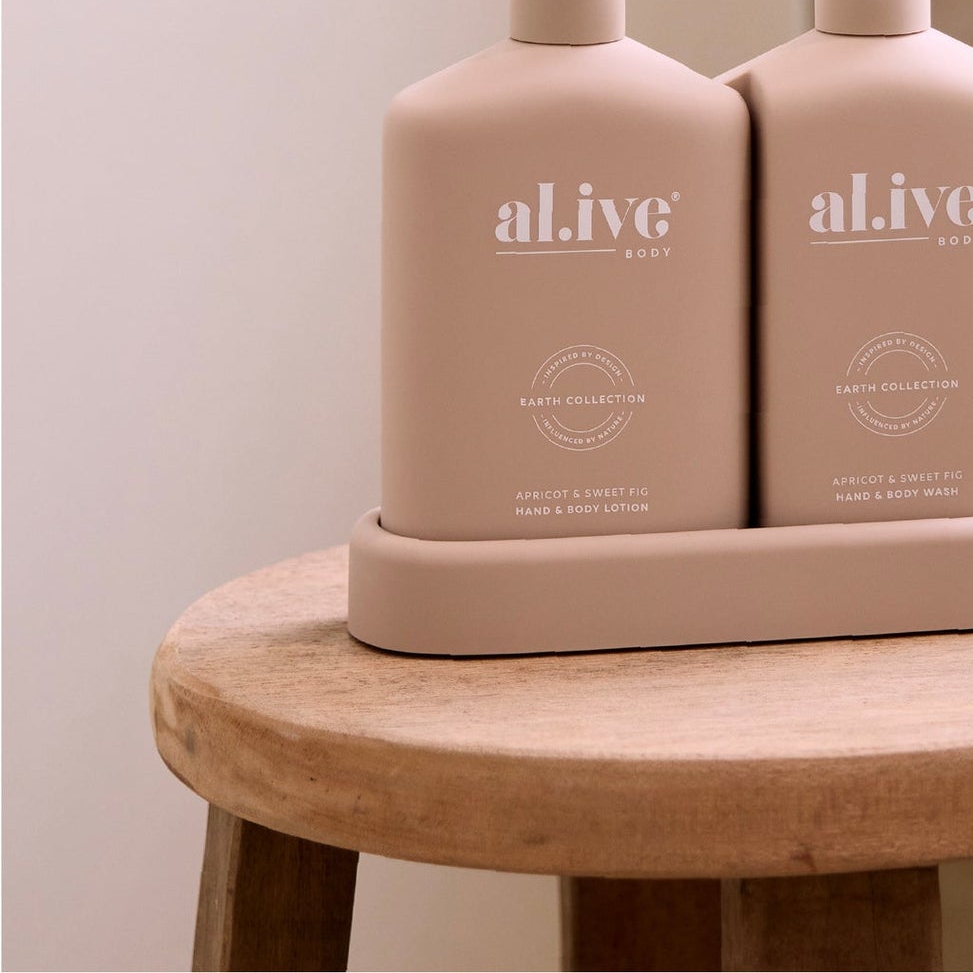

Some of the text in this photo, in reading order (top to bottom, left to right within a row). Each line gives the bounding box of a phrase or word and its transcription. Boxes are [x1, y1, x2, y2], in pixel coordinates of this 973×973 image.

[625, 247, 671, 259] BODY
[859, 339, 893, 367] INSPIRED
[909, 341, 936, 364] DESIGN
[543, 352, 579, 379] INSPIRED
[595, 353, 622, 377] DESIGN
[835, 379, 959, 394] EARTH COLLECTION
[519, 394, 645, 406] EARTH COLLECTION
[857, 400, 937, 431] INFLUENCED BY NATURE
[542, 416, 623, 445] INFLUENCED BY NATURE
[832, 470, 963, 486] APRICOT & SWEET FIG
[516, 487, 649, 500] APRICOT & SWEET FIG
[836, 487, 959, 502] HAND & BODY WASH
[516, 503, 649, 516] HAND & BODY LOTION
